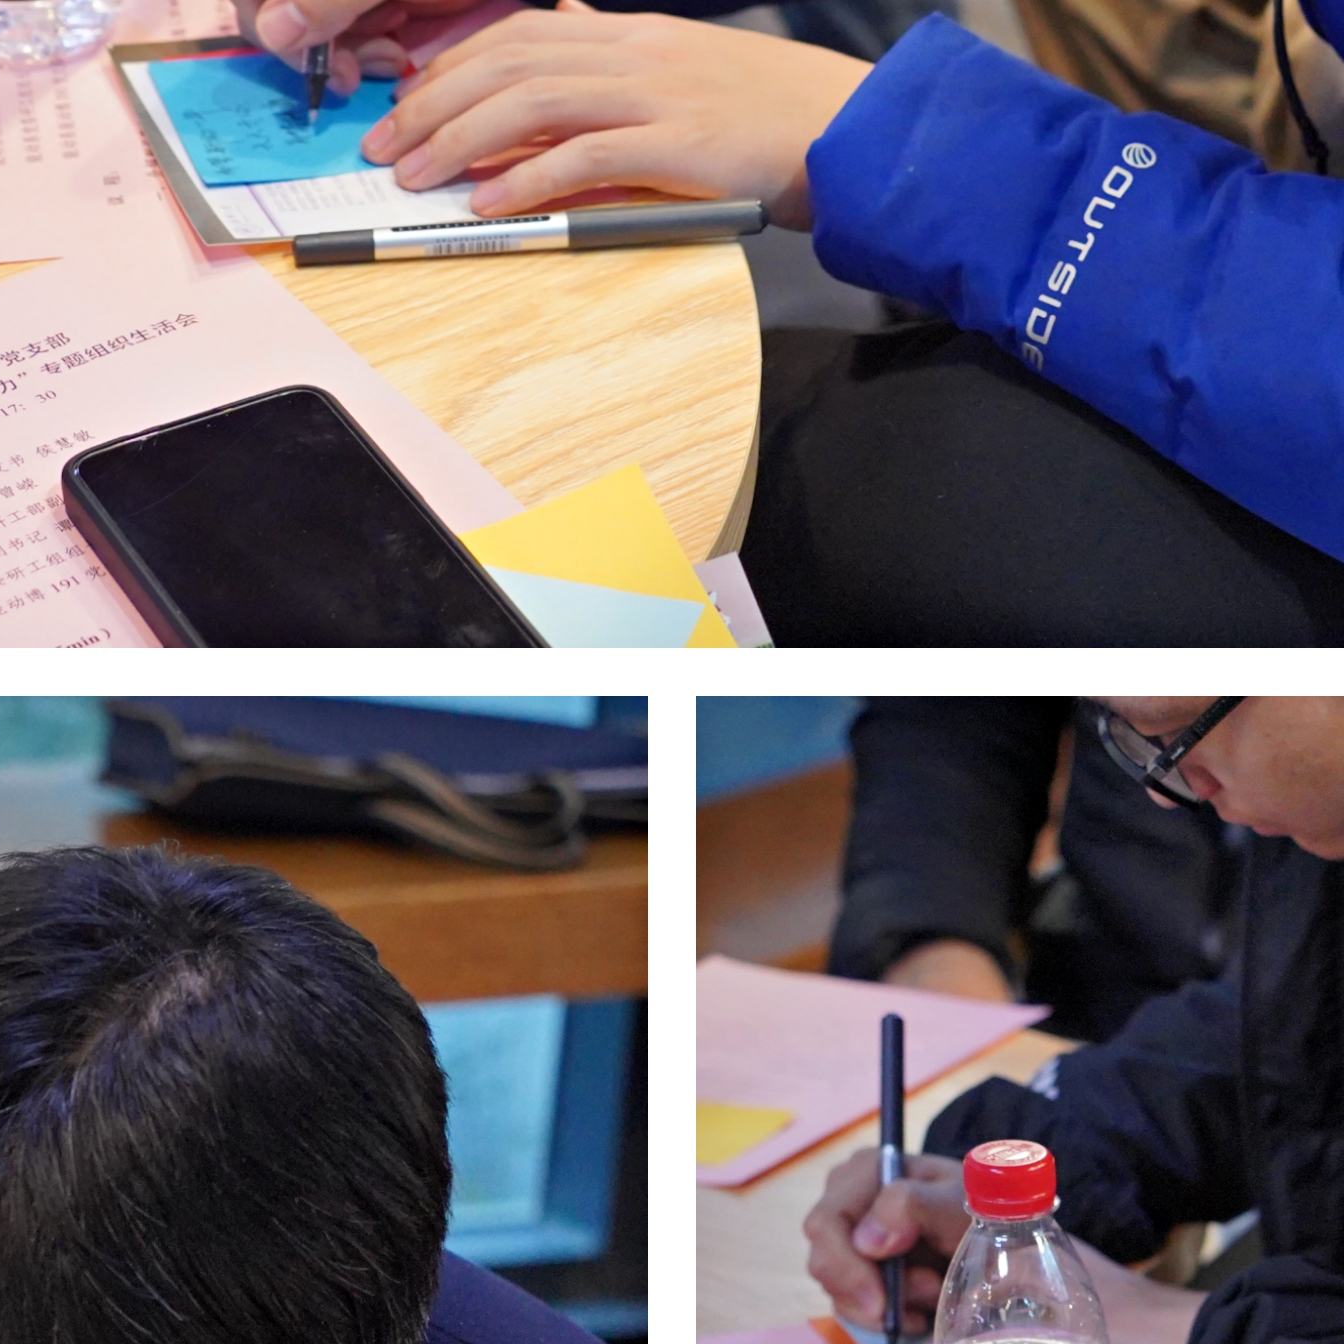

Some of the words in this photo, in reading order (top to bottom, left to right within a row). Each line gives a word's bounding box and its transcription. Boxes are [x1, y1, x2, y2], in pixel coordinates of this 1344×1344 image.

[1022, 165, 1134, 372] OUTSIDE
[0, 332, 71, 367] 党支部
[40, 313, 199, 374] 专题组织生活会
[50, 576, 81, 594] 191
